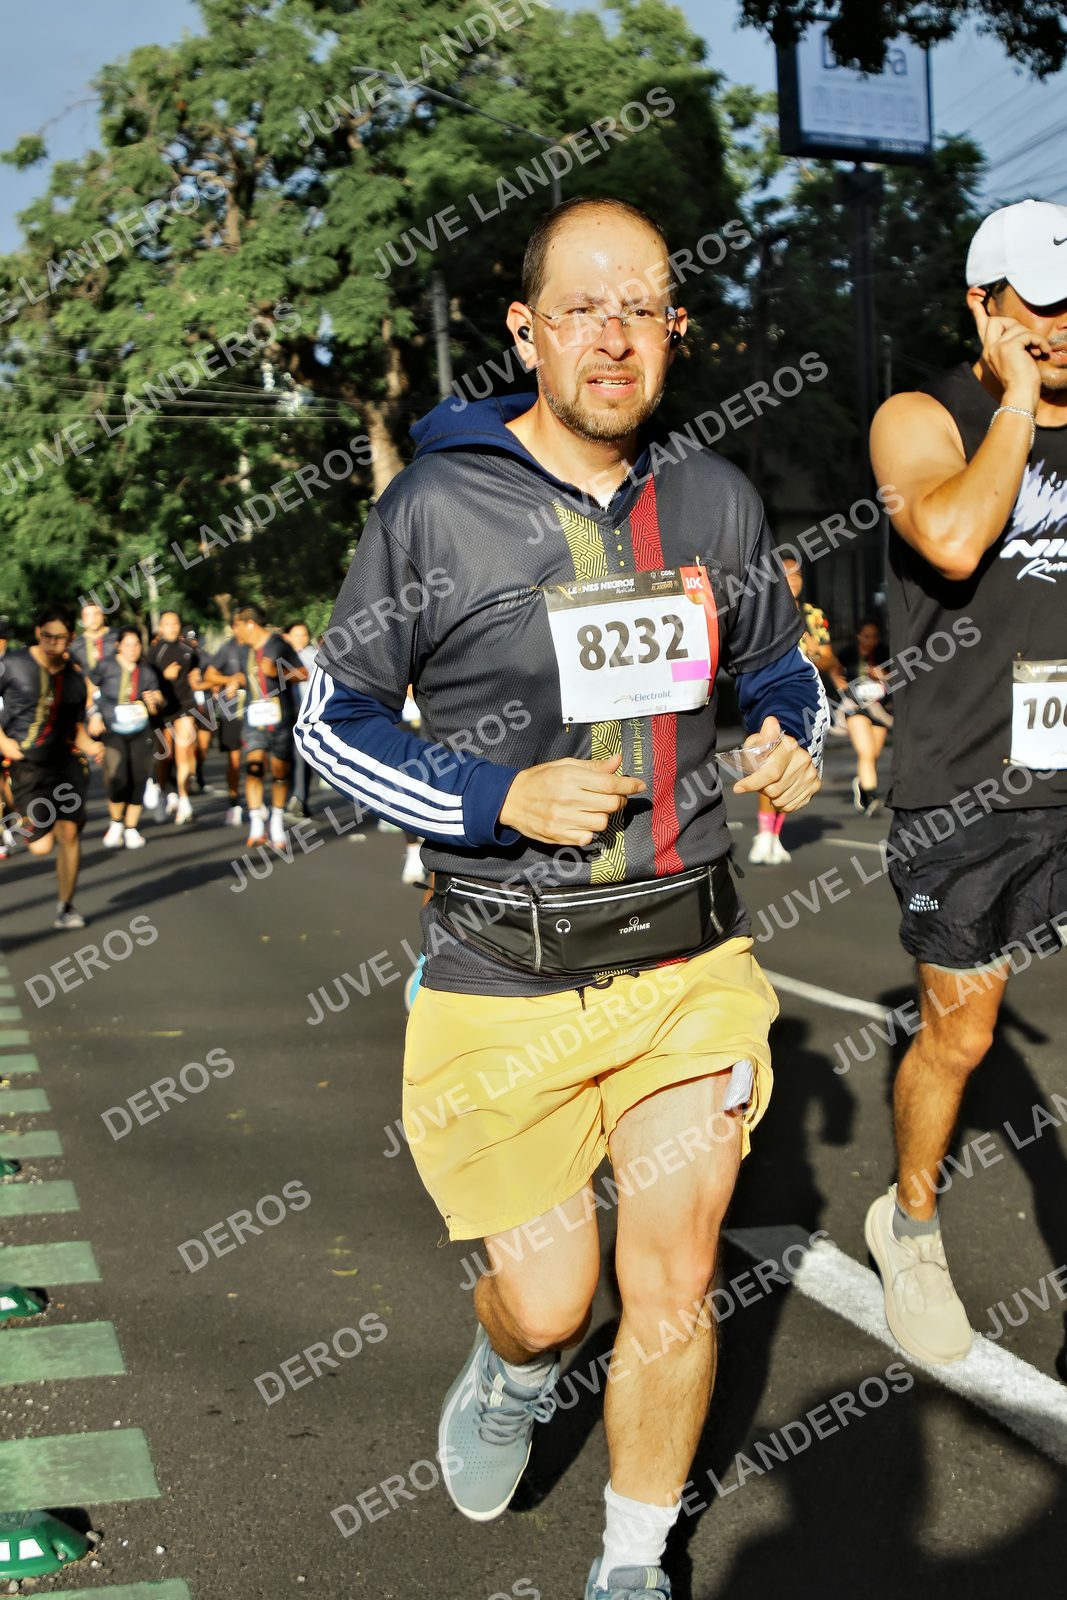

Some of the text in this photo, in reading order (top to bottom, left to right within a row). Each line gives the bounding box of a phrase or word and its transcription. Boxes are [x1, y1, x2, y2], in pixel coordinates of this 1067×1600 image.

[600, 578, 635, 590] NEGROS
[576, 613, 688, 672] 8232
[634, 690, 672, 702] Electrolit
[1023, 697, 1067, 729] 10
[619, 922, 651, 935] TOPTIME
